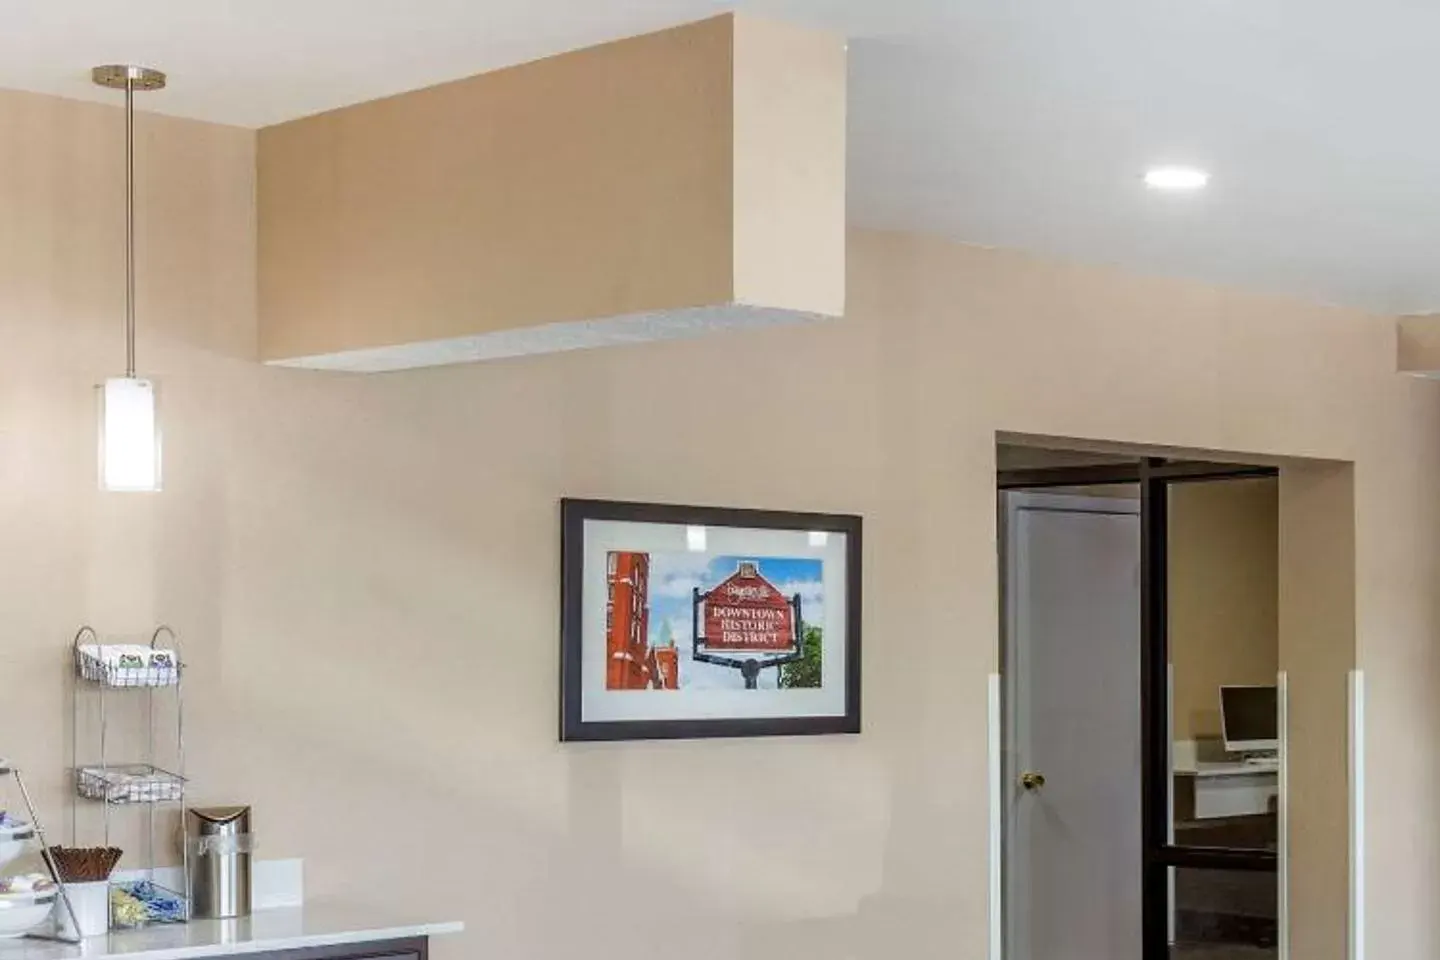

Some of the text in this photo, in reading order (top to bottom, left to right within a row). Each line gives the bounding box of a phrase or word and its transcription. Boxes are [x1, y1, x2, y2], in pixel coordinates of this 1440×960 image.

[713, 606, 785, 619] DOWNTOWN
[721, 619, 780, 631] HISTORIC
[723, 631, 777, 643] DISTRICT
